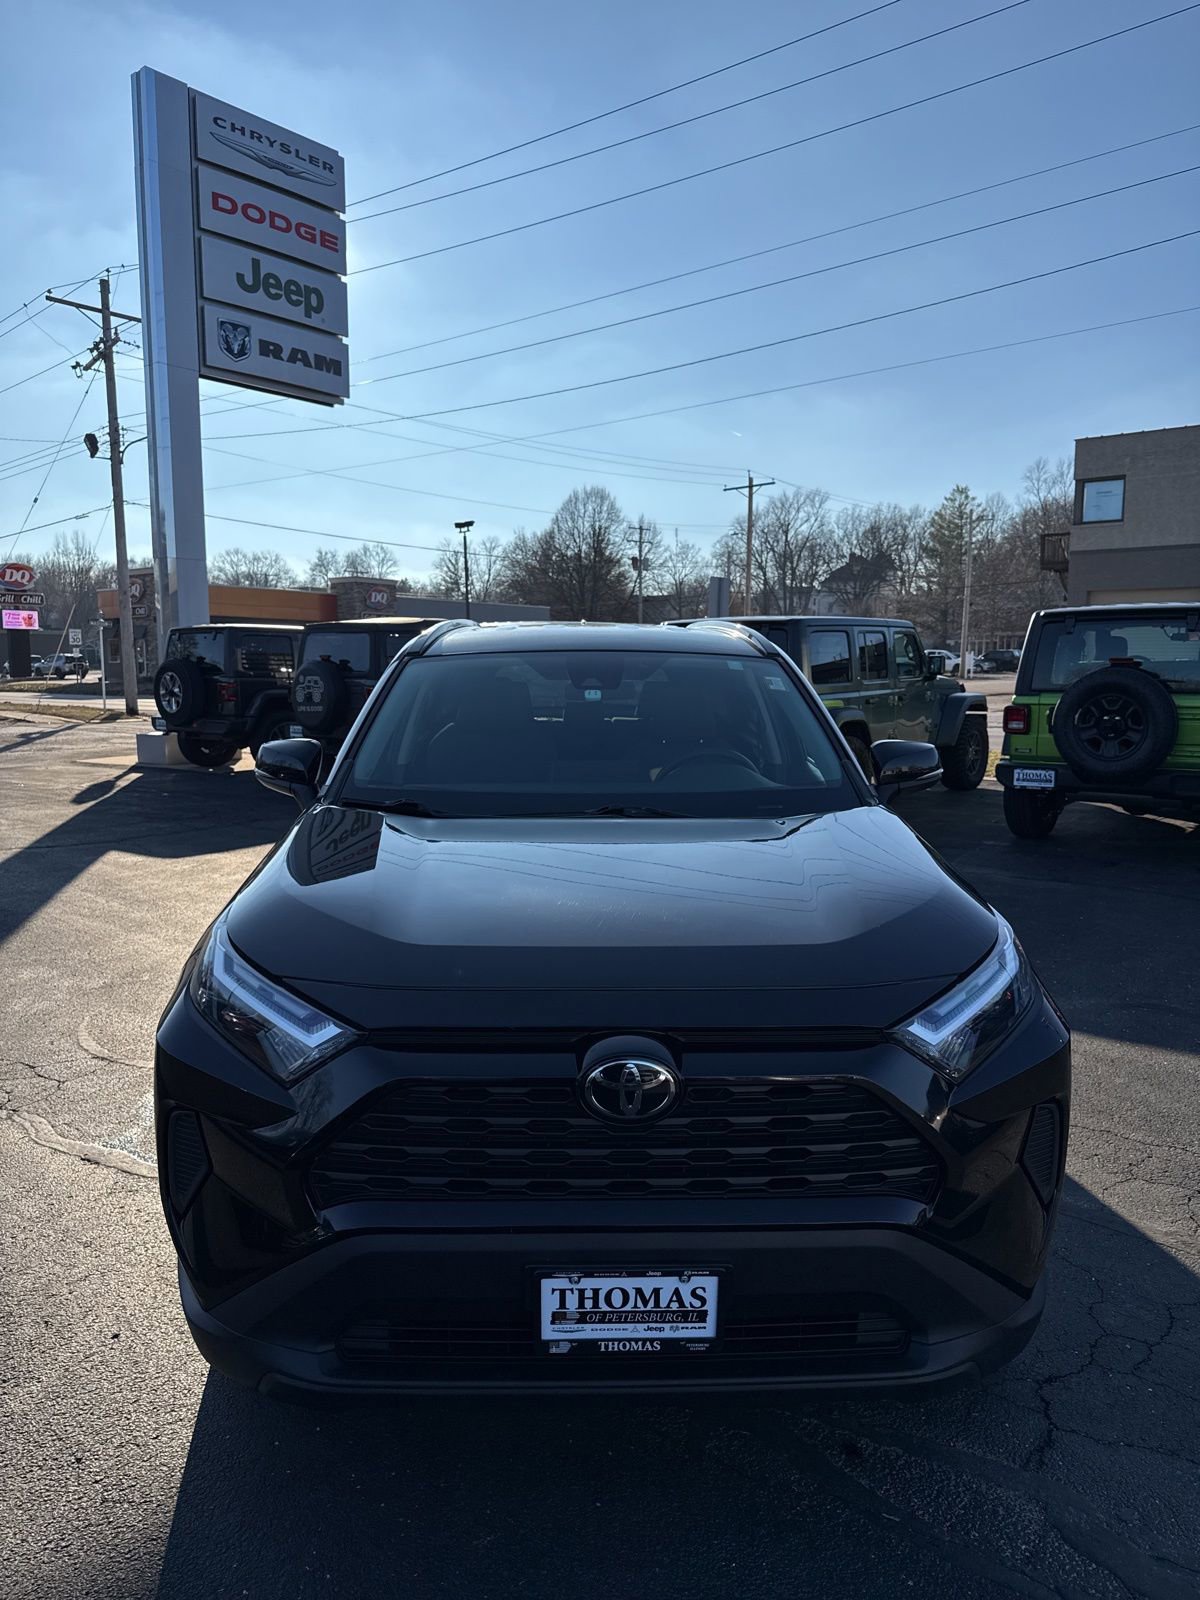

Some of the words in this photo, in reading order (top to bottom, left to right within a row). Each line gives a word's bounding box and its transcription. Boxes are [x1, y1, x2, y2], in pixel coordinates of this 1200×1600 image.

[212, 116, 335, 174] CHRYSLER
[211, 191, 339, 253] DODGE
[236, 258, 325, 319] Jeep
[259, 338, 342, 376] RAM
[4, 569, 31, 584] DQ
[21, 595, 42, 604] Chill
[371, 592, 388, 605] DQ
[1016, 771, 1053, 780] THOMAS
[551, 1286, 708, 1310] THOMAS
[586, 1313, 602, 1323] OF
[605, 1312, 685, 1323] PETERSBURG,
[688, 1312, 700, 1322] IL
[643, 1325, 665, 1333] Jeep
[598, 1341, 661, 1351] THOMAS
